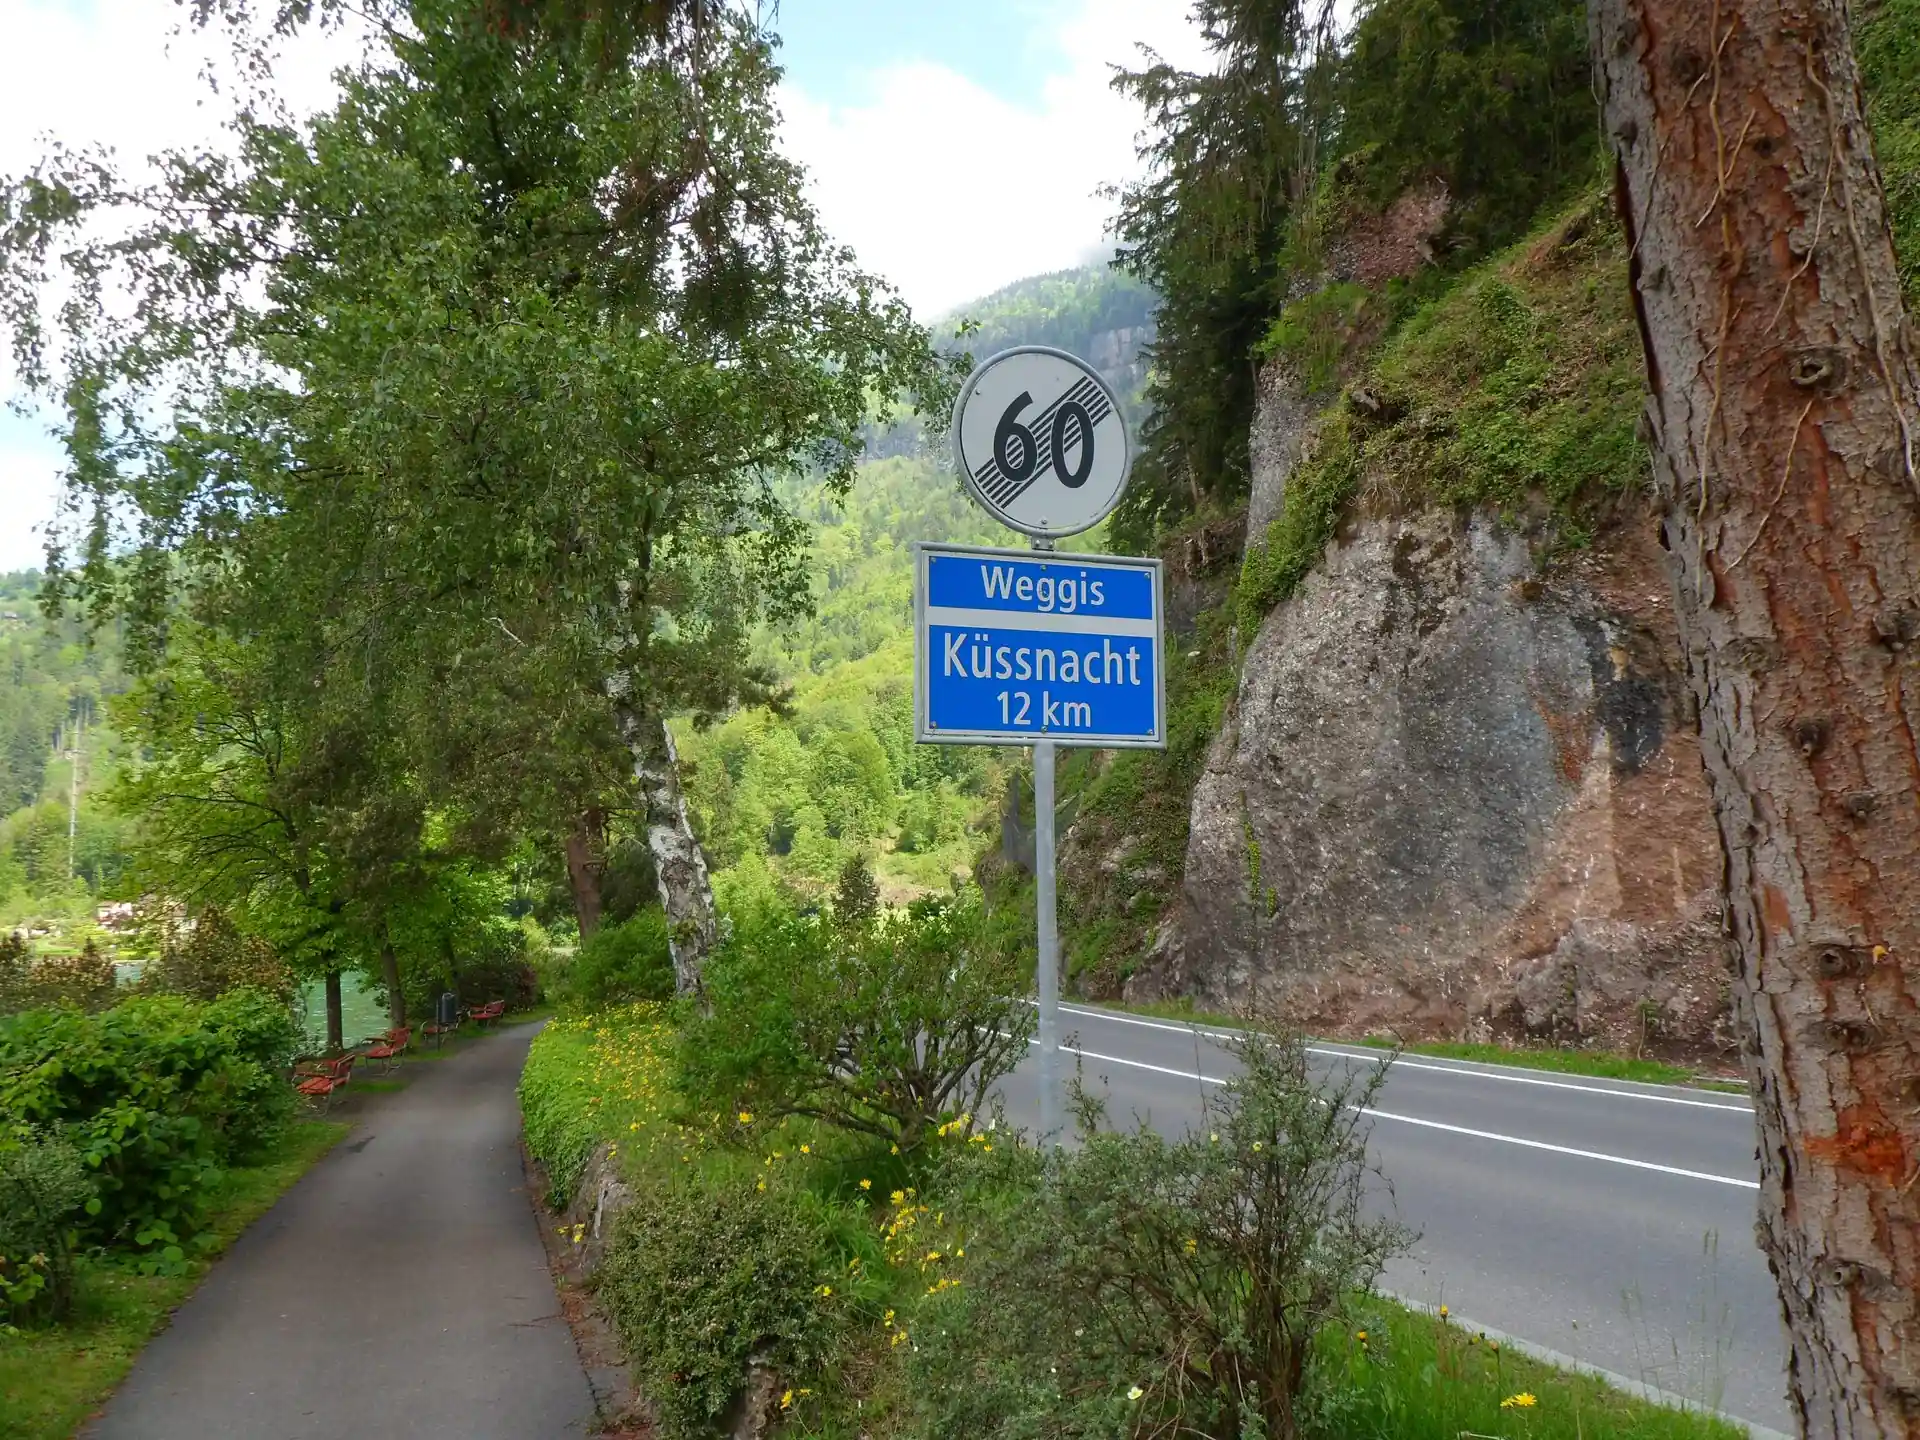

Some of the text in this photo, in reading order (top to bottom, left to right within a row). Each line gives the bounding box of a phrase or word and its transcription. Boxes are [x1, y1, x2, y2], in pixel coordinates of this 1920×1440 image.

[993, 390, 1095, 489] 60
[981, 565, 1105, 614] Weggis
[944, 632, 1141, 686] Küssnacht
[997, 691, 1092, 728] 12 km
